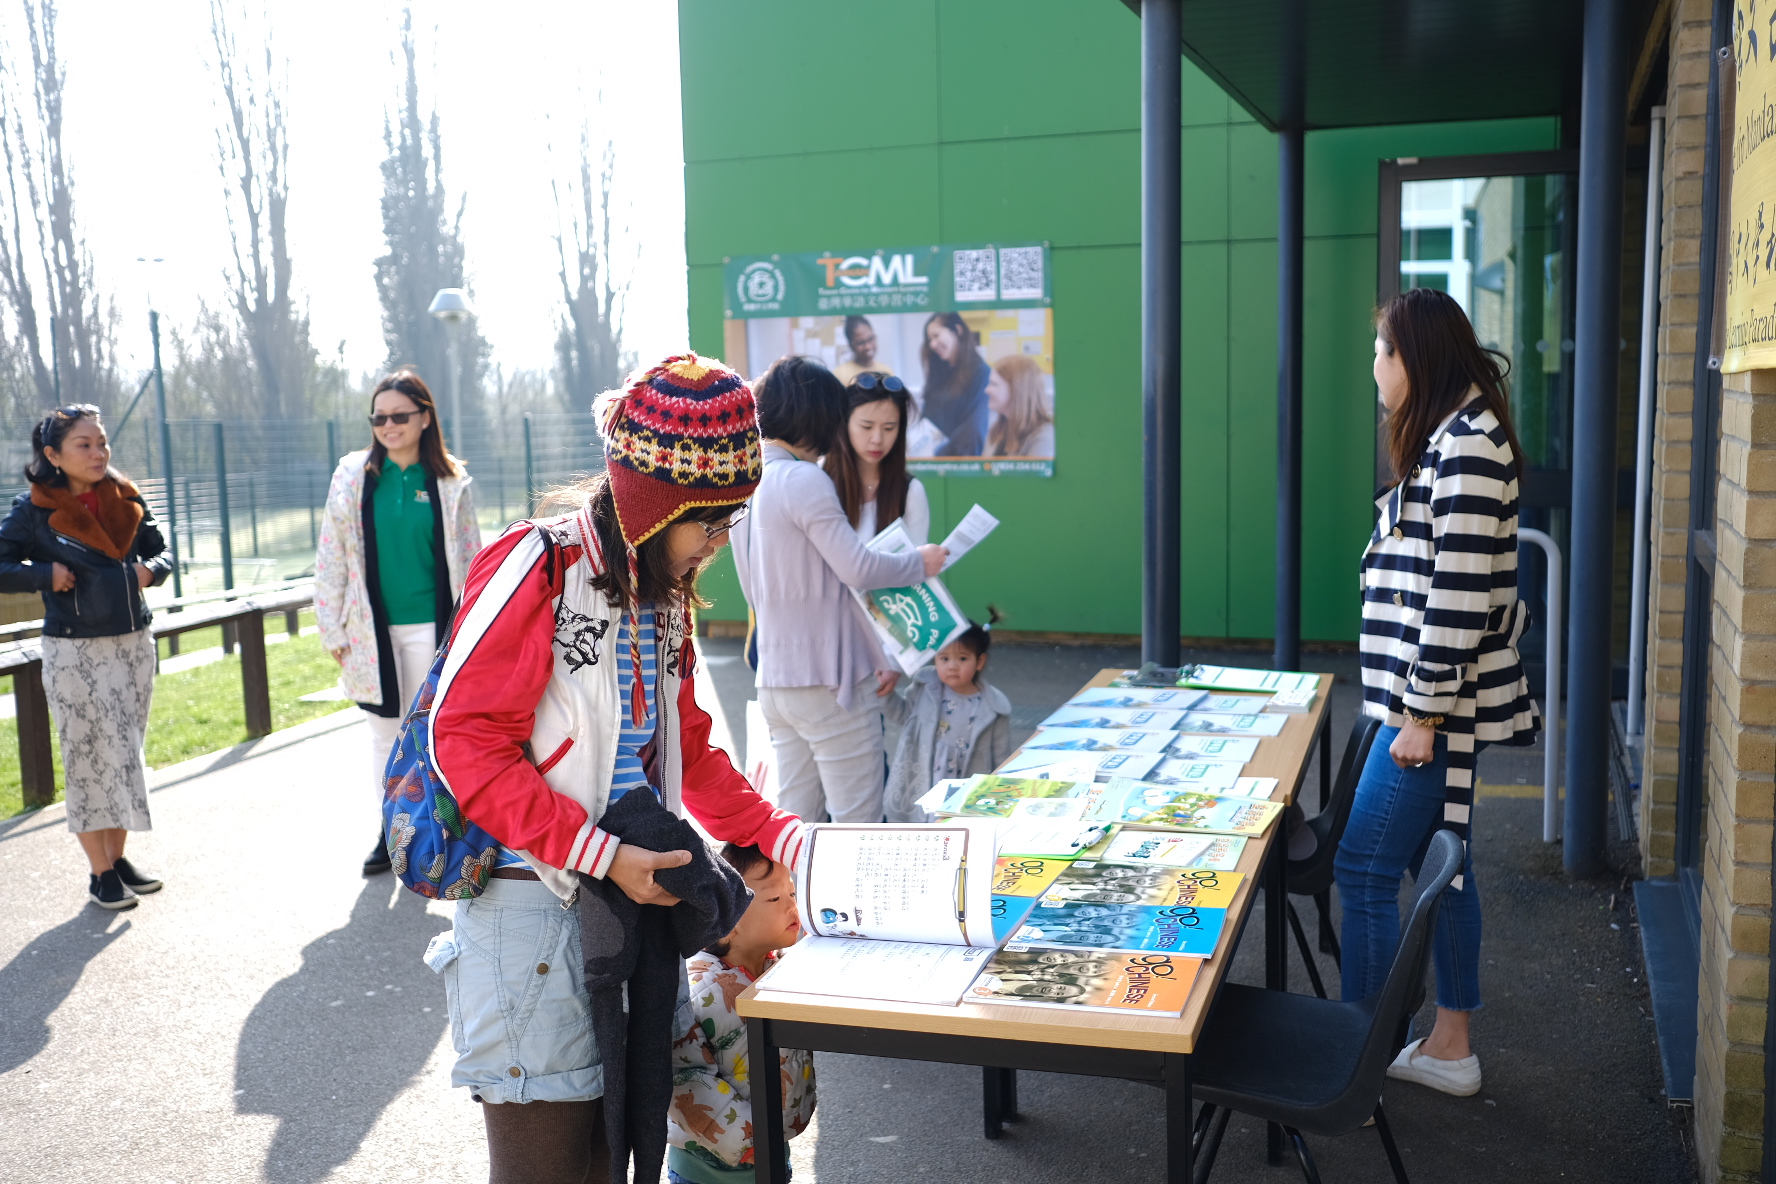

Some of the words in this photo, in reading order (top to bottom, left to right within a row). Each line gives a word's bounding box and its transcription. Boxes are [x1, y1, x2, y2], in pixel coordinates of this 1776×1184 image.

[1745, 92, 1776, 160] Manda
[816, 254, 929, 287] TCML
[1748, 302, 1776, 344] Parad
[911, 583, 939, 622] RNING
[1180, 870, 1221, 890] go!
[1154, 916, 1180, 949] CHINESE
[1157, 906, 1204, 930] go!
[1128, 954, 1177, 981] go!
[1120, 965, 1150, 1004] CHINESE
